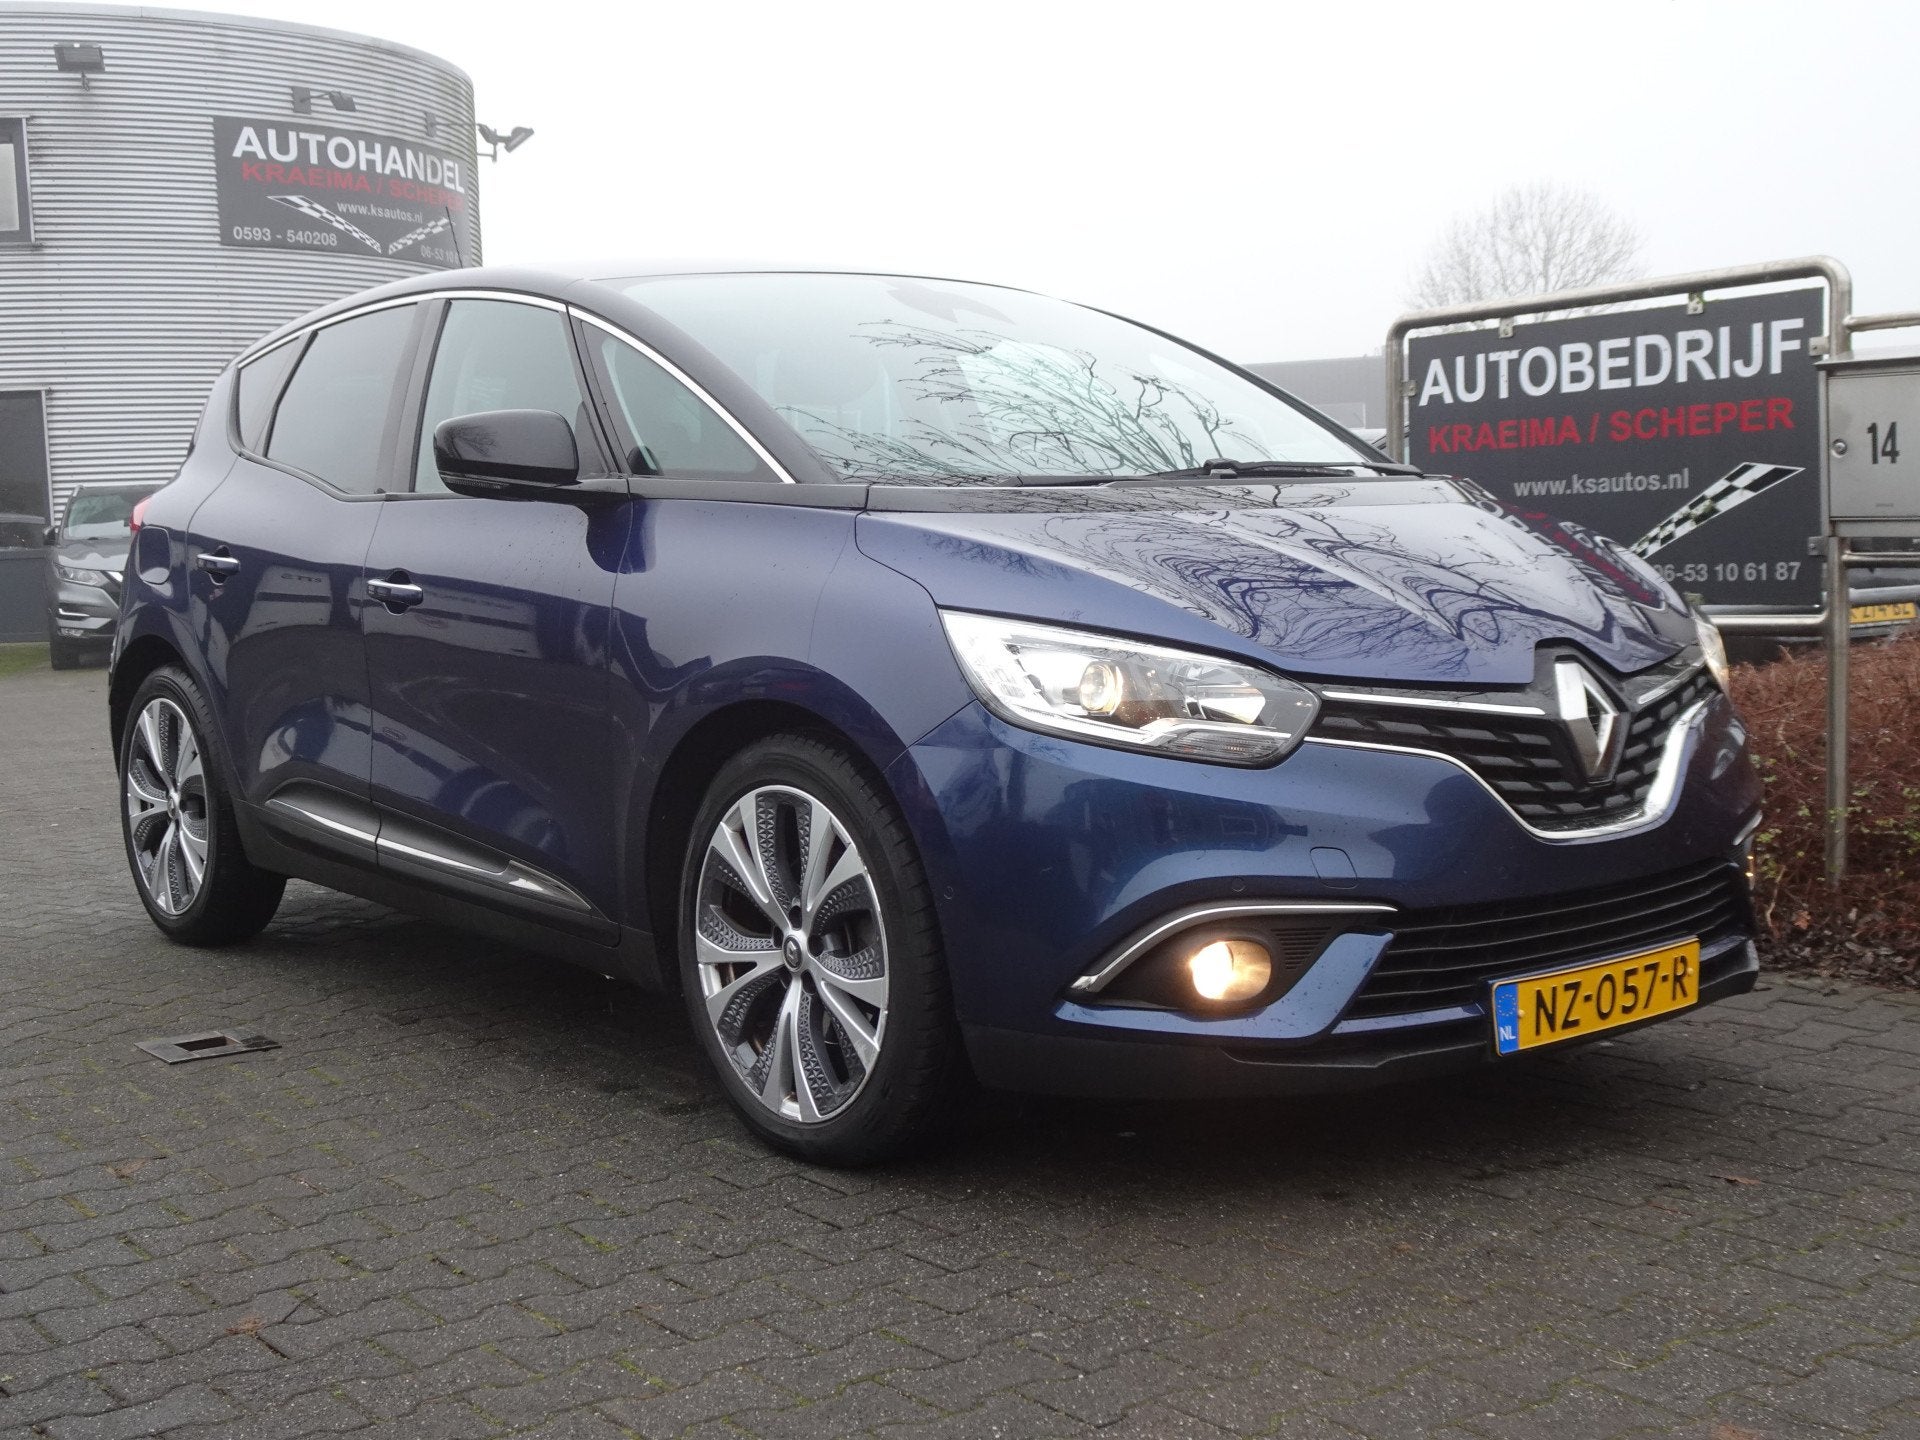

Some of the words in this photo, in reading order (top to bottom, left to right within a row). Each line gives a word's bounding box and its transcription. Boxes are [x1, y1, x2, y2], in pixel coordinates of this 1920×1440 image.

[232, 126, 465, 193] AUTOHANDEL
[241, 161, 372, 194] KRAEIMA
[375, 178, 383, 194] /
[388, 179, 465, 212] SCHEPER
[336, 200, 423, 225] www.ksautos.nl
[233, 226, 271, 242] 0593
[286, 230, 338, 246] 540208
[1418, 317, 1804, 407] AUTOBEDRIJF
[1429, 417, 1581, 454] KRAEIMA
[1589, 412, 1600, 443] /
[1609, 397, 1796, 442] SCHEPER
[1867, 421, 1900, 464] 14
[1514, 468, 1690, 498] www.ksautos.nl
[1714, 562, 1739, 582] 10
[1743, 562, 1767, 582] 61
[1775, 561, 1801, 581] 87
[1535, 955, 1689, 1037] NZ-057-R
[1499, 1025, 1516, 1042] NL
